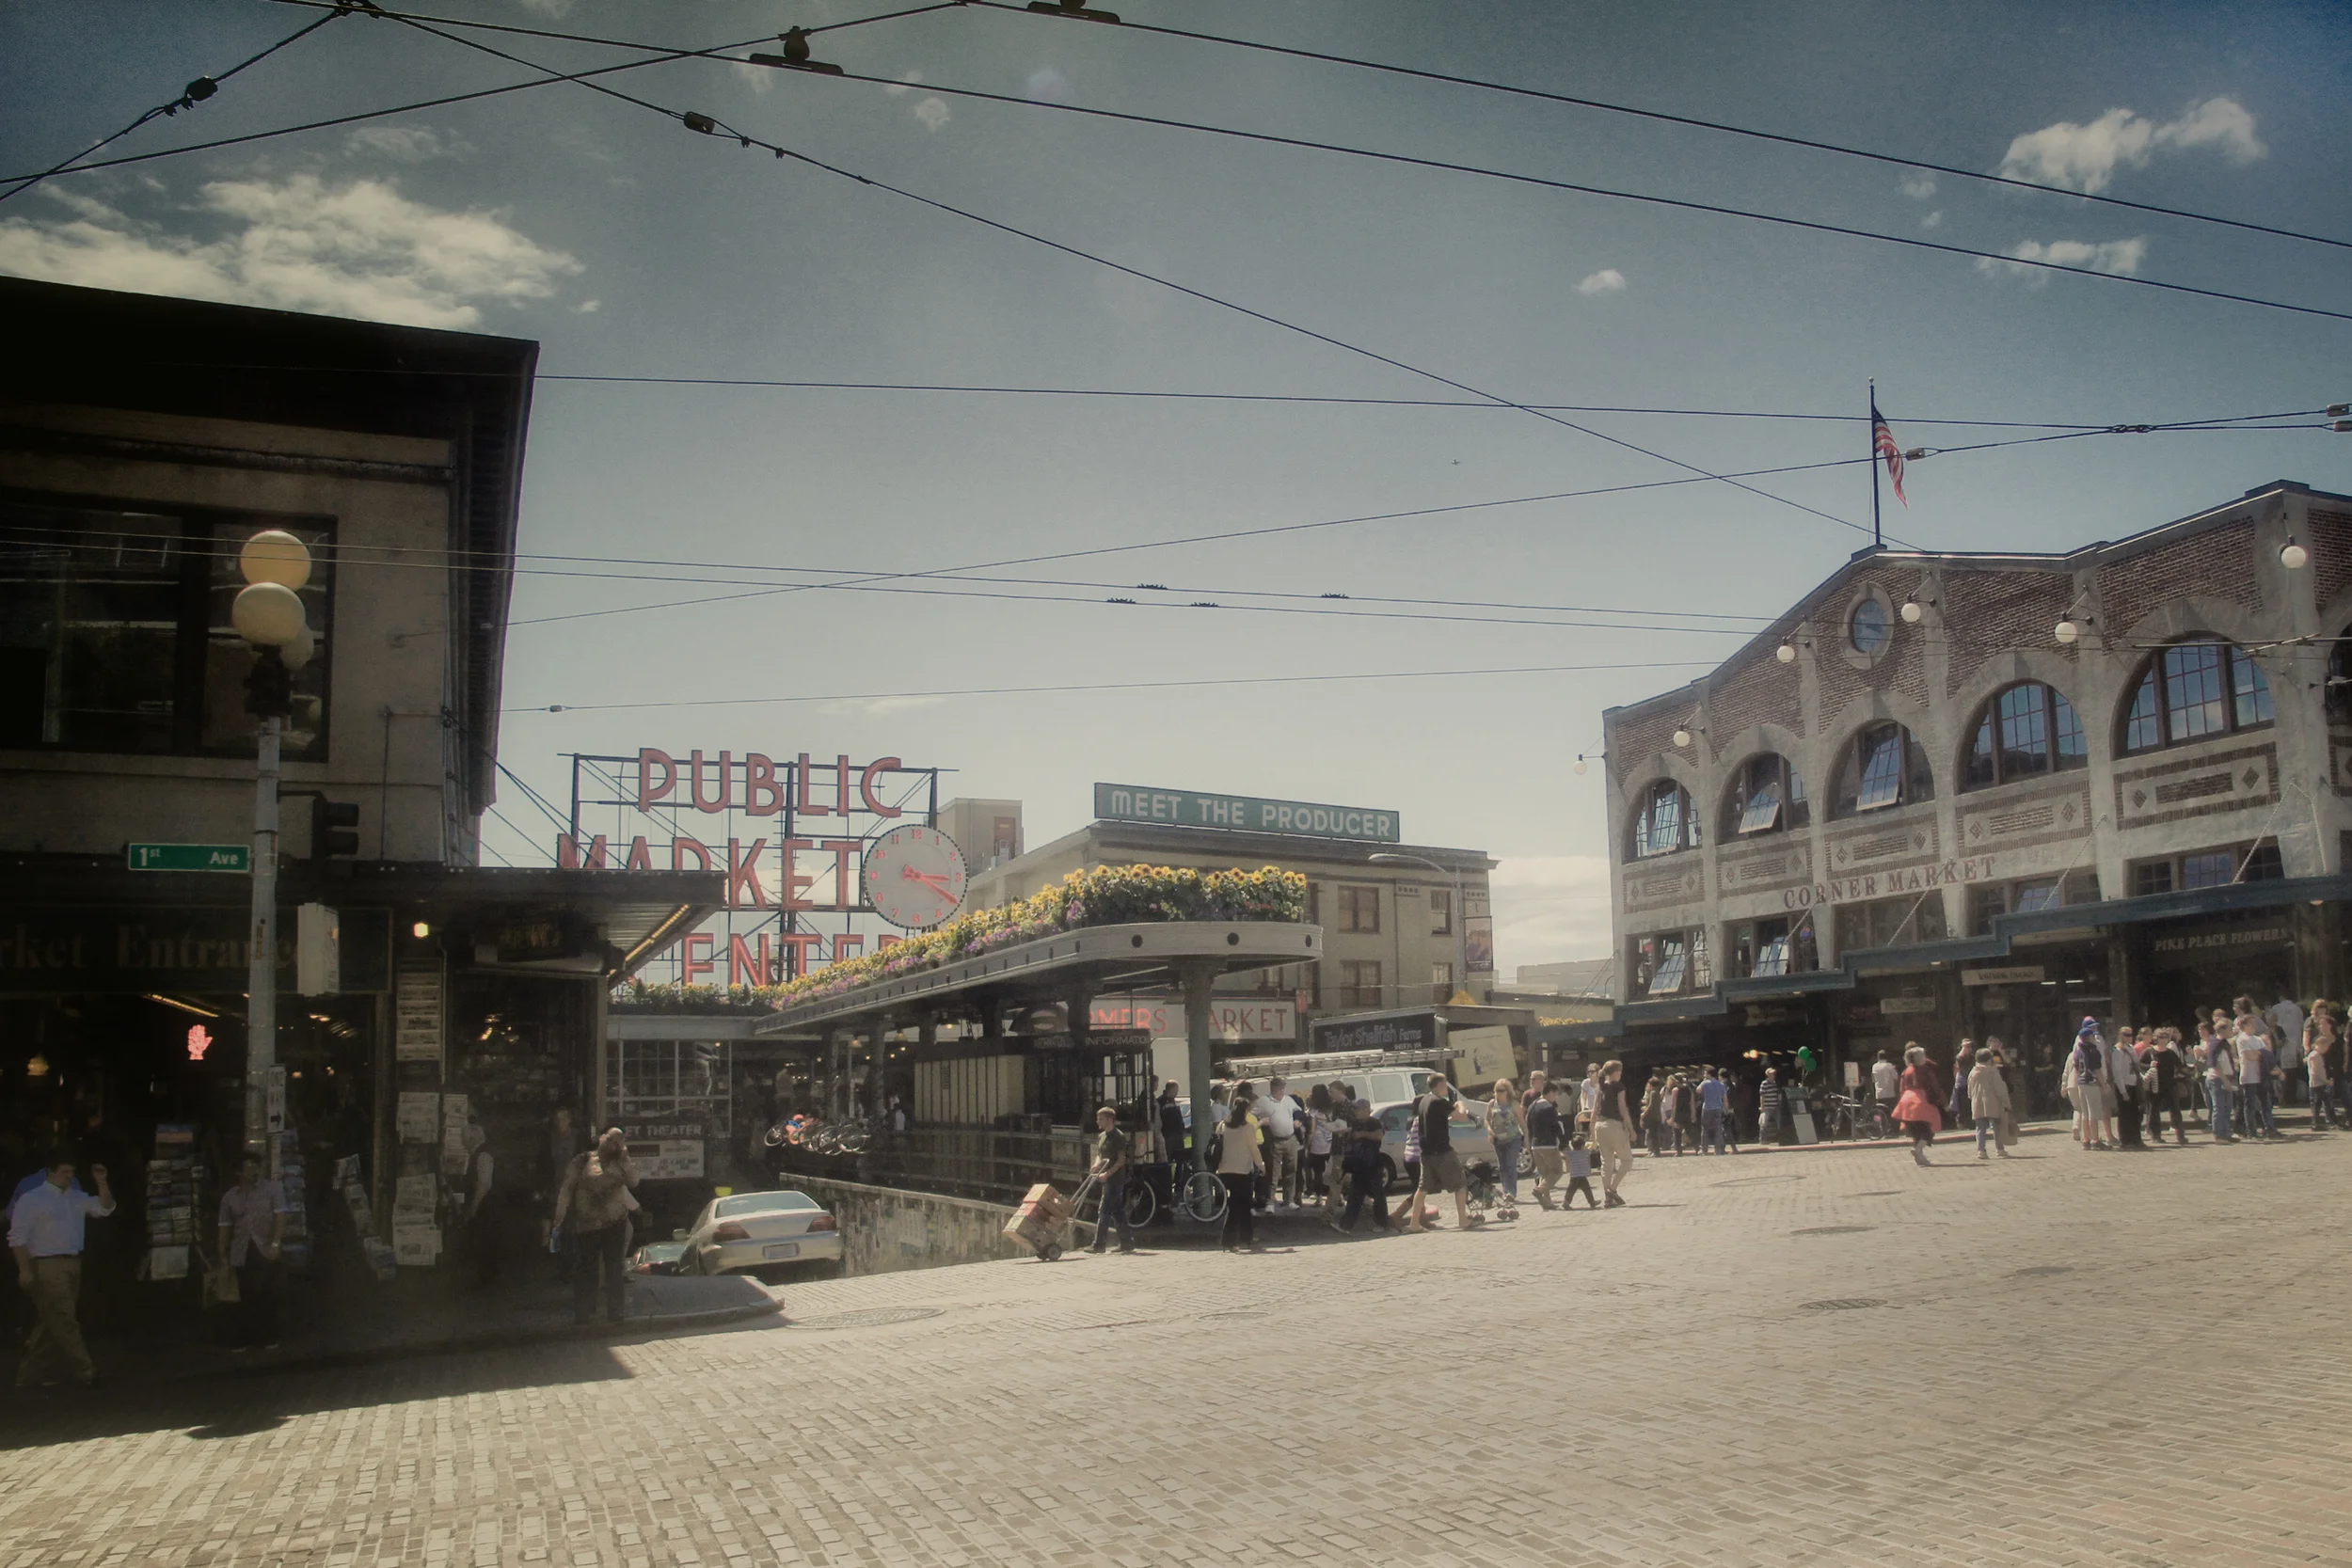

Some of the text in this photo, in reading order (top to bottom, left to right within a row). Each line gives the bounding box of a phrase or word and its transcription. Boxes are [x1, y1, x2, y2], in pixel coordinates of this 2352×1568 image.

[638, 747, 902, 817] PUBLIC
[1111, 789, 1391, 837] MEET THE PRODUCER
[139, 847, 239, 866] 1st Ave
[1784, 856, 1996, 909] CORNER MARKET
[0, 923, 299, 969] rket Entranc
[2155, 927, 2288, 951] PIKE PLACE FLOWERS
[682, 932, 902, 988] ENT
[1089, 1007, 1288, 1033] MERS ARKET
[1324, 1023, 1422, 1052] Taylor Shellfish Farms
[646, 1124, 703, 1136] THEATER
